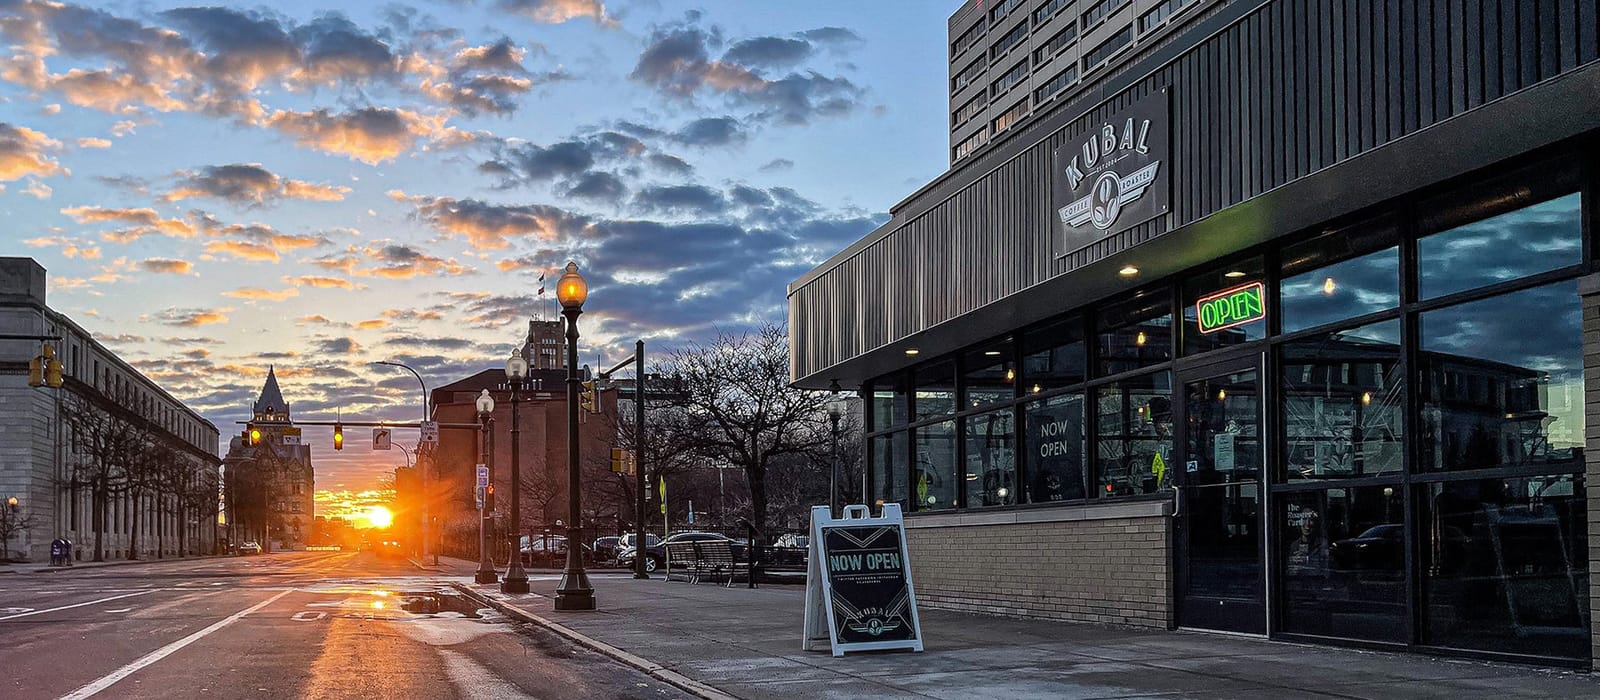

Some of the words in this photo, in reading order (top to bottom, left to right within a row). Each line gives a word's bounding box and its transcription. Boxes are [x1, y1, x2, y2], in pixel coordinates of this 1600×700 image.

[1065, 118, 1151, 190] KUBAL
[1122, 171, 1150, 189] ROASTER
[1064, 201, 1088, 217] COFFEE
[1201, 287, 1262, 328] OPEN
[1041, 419, 1068, 438] NOW
[1040, 440, 1067, 457] OPEN
[830, 554, 863, 572] NOW
[866, 553, 900, 570] OPEN
